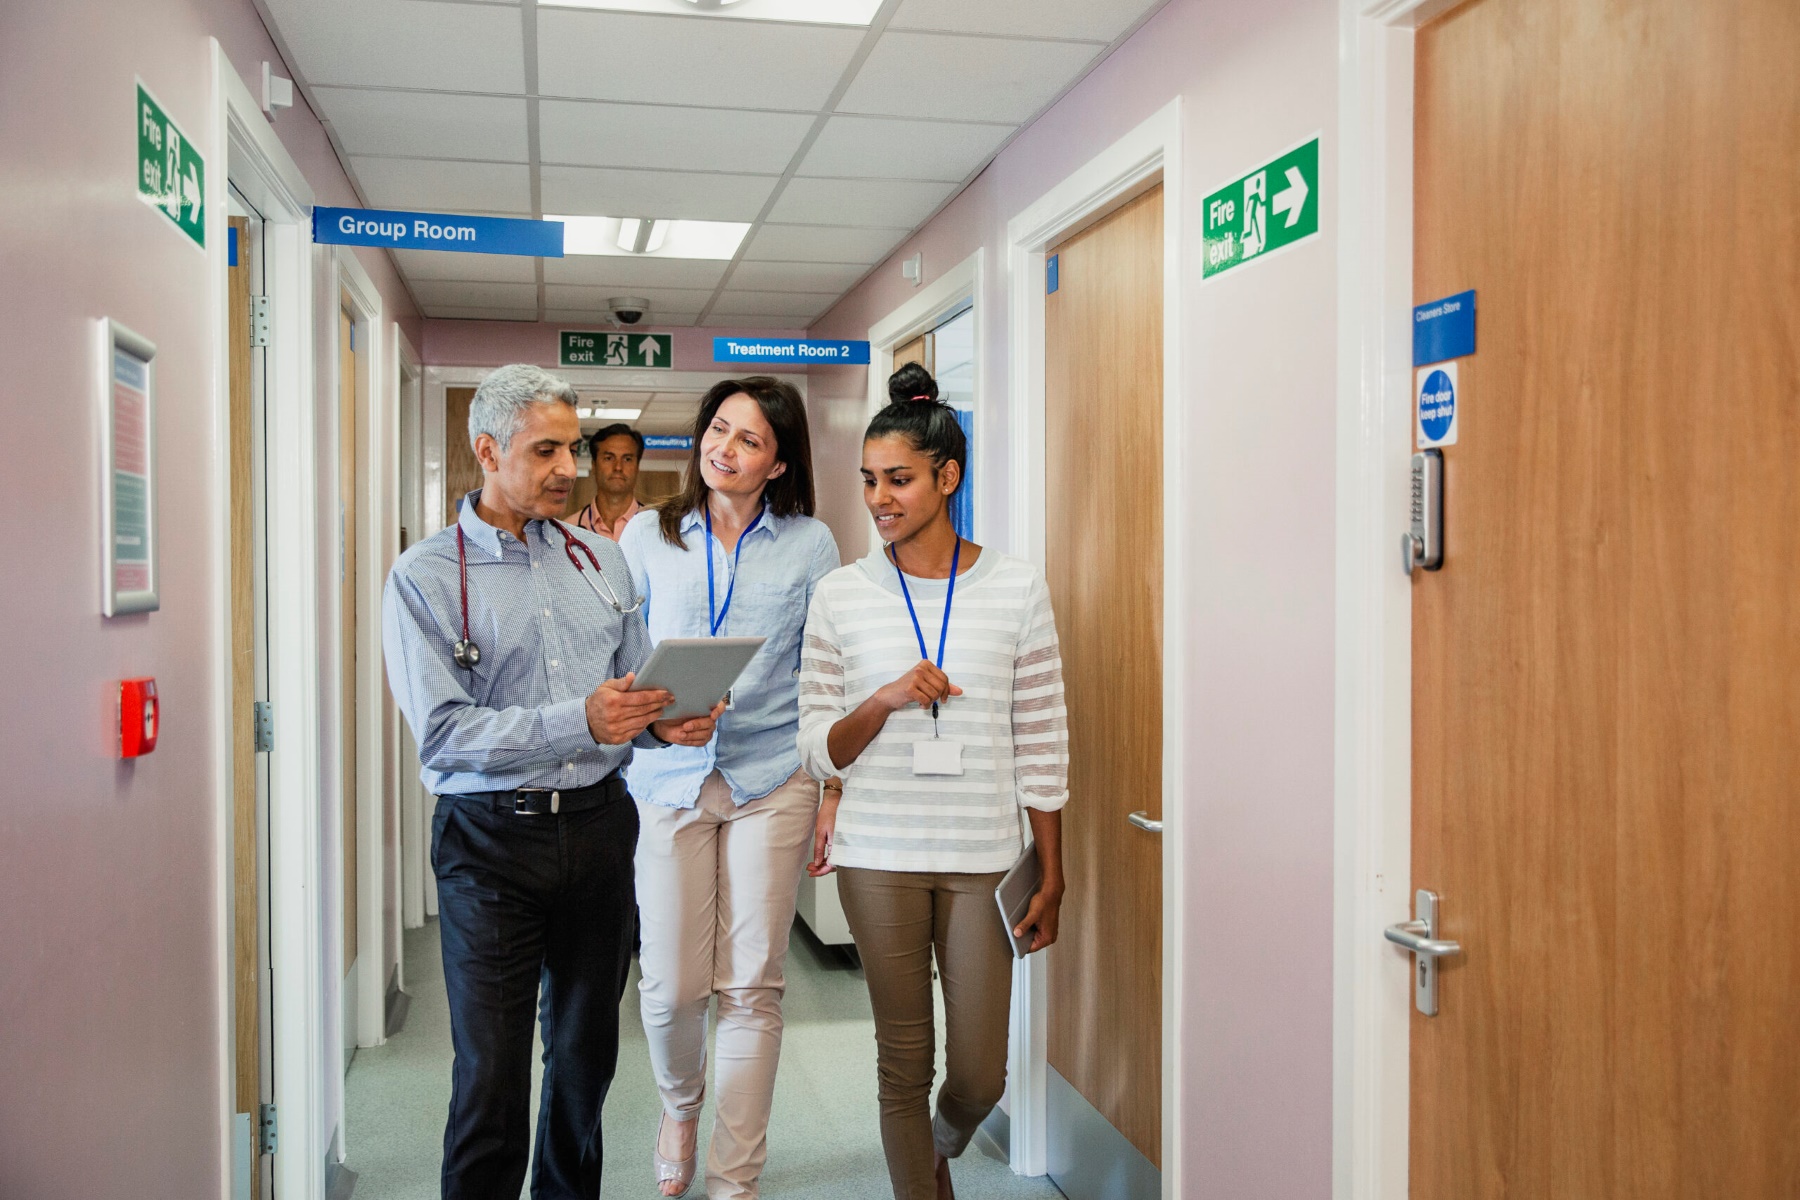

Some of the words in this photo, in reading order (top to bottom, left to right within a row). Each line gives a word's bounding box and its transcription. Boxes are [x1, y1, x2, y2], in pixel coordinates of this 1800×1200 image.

[143, 103, 162, 151] Fire
[144, 158, 162, 196] exit
[1209, 199, 1235, 231] Fire
[338, 215, 407, 241] Group
[414, 219, 476, 241] Room
[1209, 231, 1234, 265] exit
[1416, 305, 1443, 322] Cleaners
[1443, 301, 1460, 315] Store
[568, 335, 594, 348] Fire
[727, 342, 795, 357] Treatment
[798, 344, 838, 357] Room
[841, 345, 850, 357] 2
[569, 349, 594, 362] exit
[1421, 393, 1435, 405] Fire
[1435, 391, 1452, 403] door
[1420, 409, 1436, 421] keep
[1437, 404, 1453, 418] shut
[645, 437, 688, 448] Consulting
